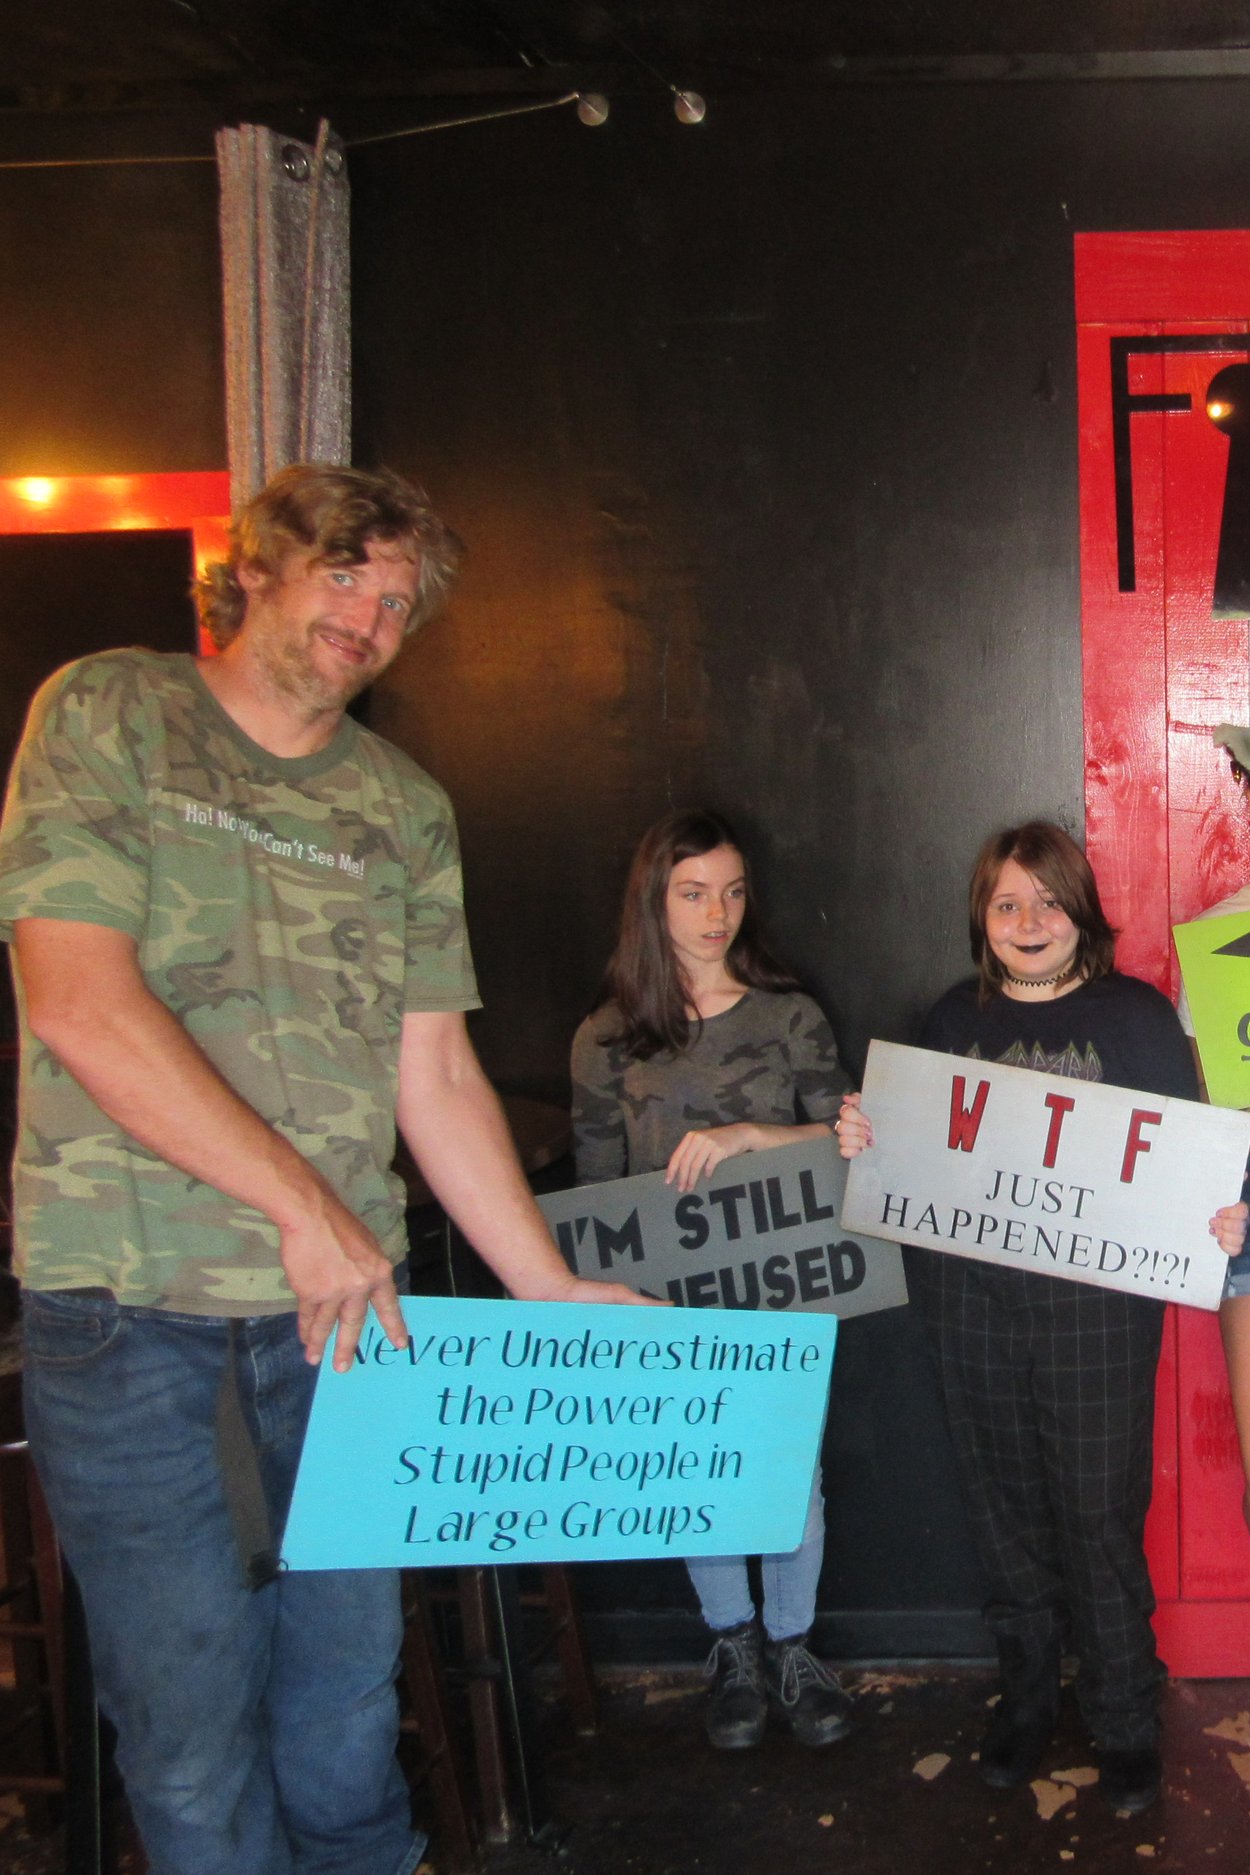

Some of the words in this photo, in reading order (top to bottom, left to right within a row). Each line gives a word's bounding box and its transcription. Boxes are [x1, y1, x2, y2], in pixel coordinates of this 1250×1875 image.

[262, 832, 304, 860] Can't
[307, 844, 336, 867] See
[338, 852, 366, 878] Me!
[985, 1169, 1096, 1219] JUST
[556, 1206, 646, 1276] I'M
[674, 1169, 835, 1250] STILL
[880, 1192, 1191, 1289] HAPPENED?!?!
[501, 1327, 821, 1373] Underestimate
[437, 1384, 514, 1427] the
[523, 1387, 676, 1426] Power
[683, 1387, 733, 1425] of
[394, 1442, 553, 1495] Stupid
[559, 1442, 700, 1491] People
[707, 1443, 743, 1479] in
[403, 1504, 549, 1552] Large
[559, 1500, 716, 1545] Groups
